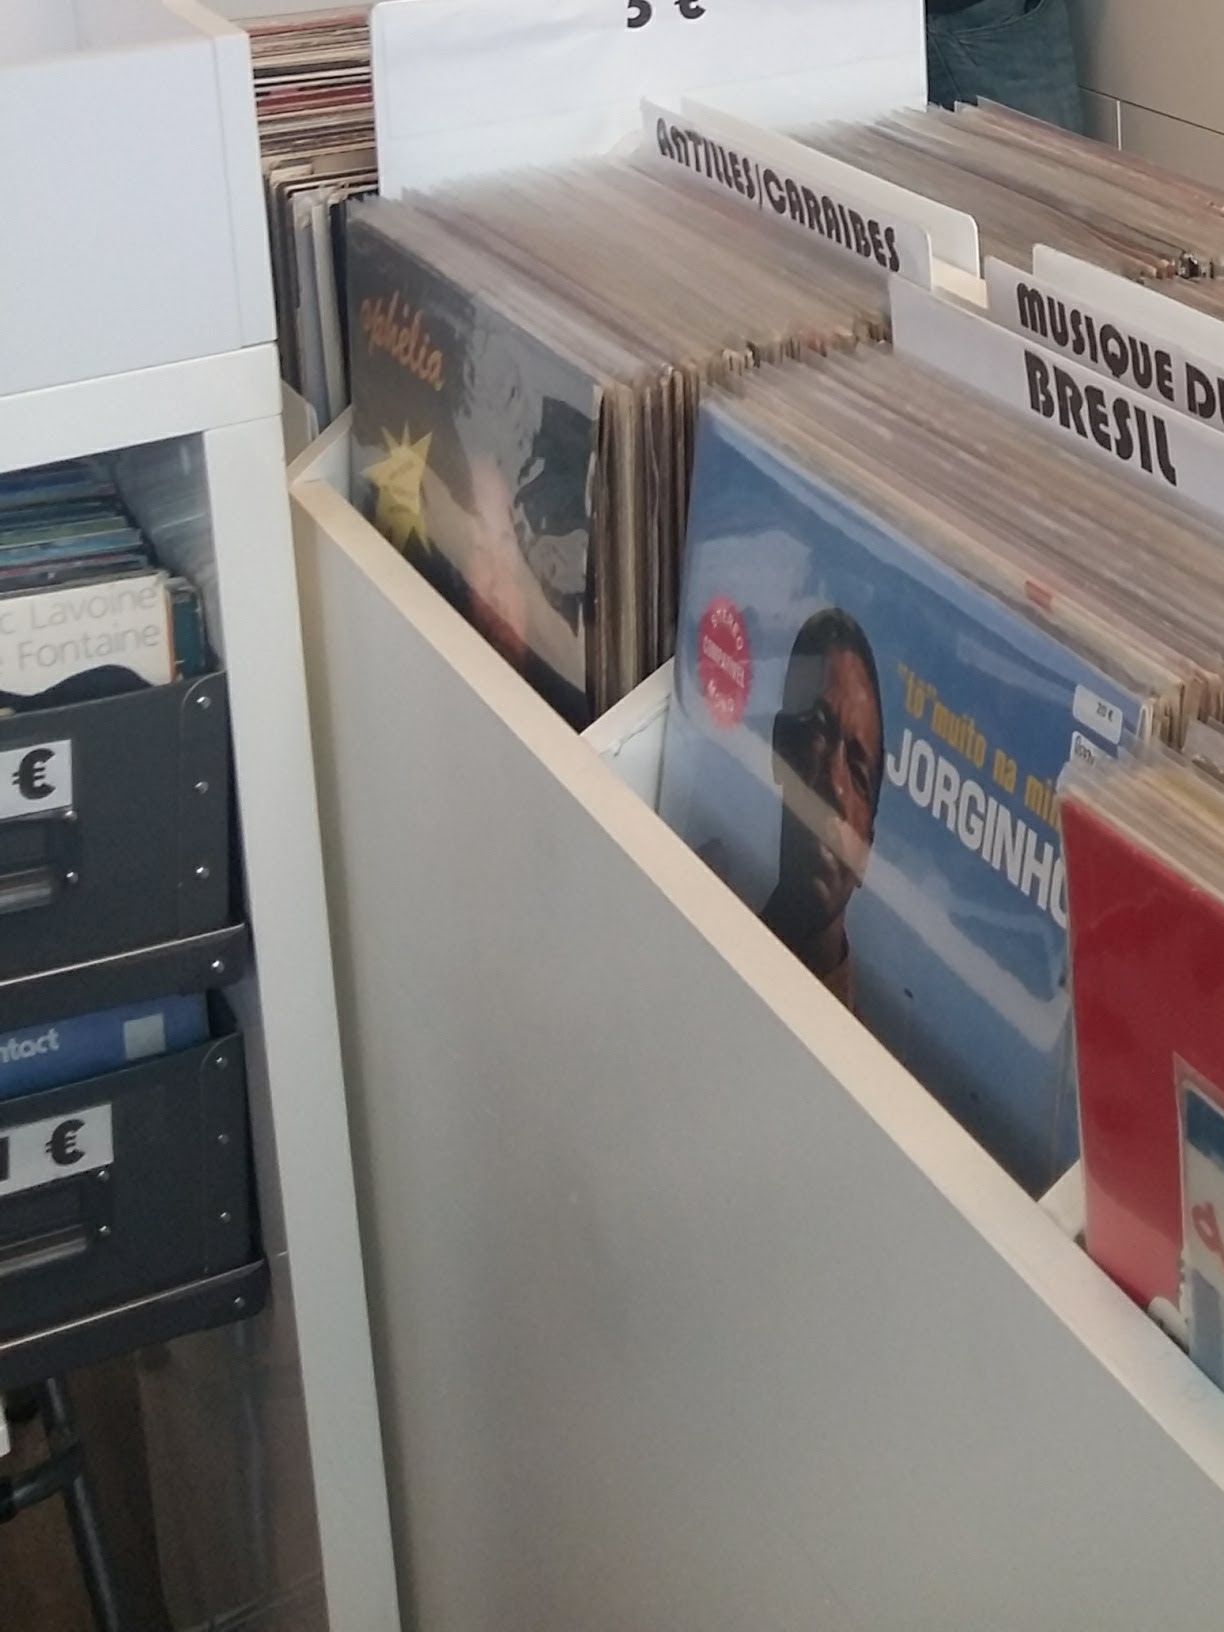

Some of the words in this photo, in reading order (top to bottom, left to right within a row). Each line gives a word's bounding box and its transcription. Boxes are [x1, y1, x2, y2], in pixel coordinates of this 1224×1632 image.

[656, 118, 900, 273] ANTILLES/CARAIBES
[1016, 282, 1174, 402] MUSIQUE
[1024, 349, 1178, 487] BRESIL
[30, 584, 157, 631] Lavoine
[17, 621, 160, 671] Fontaine
[11, 748, 56, 800] €
[45, 1119, 86, 1166] €
